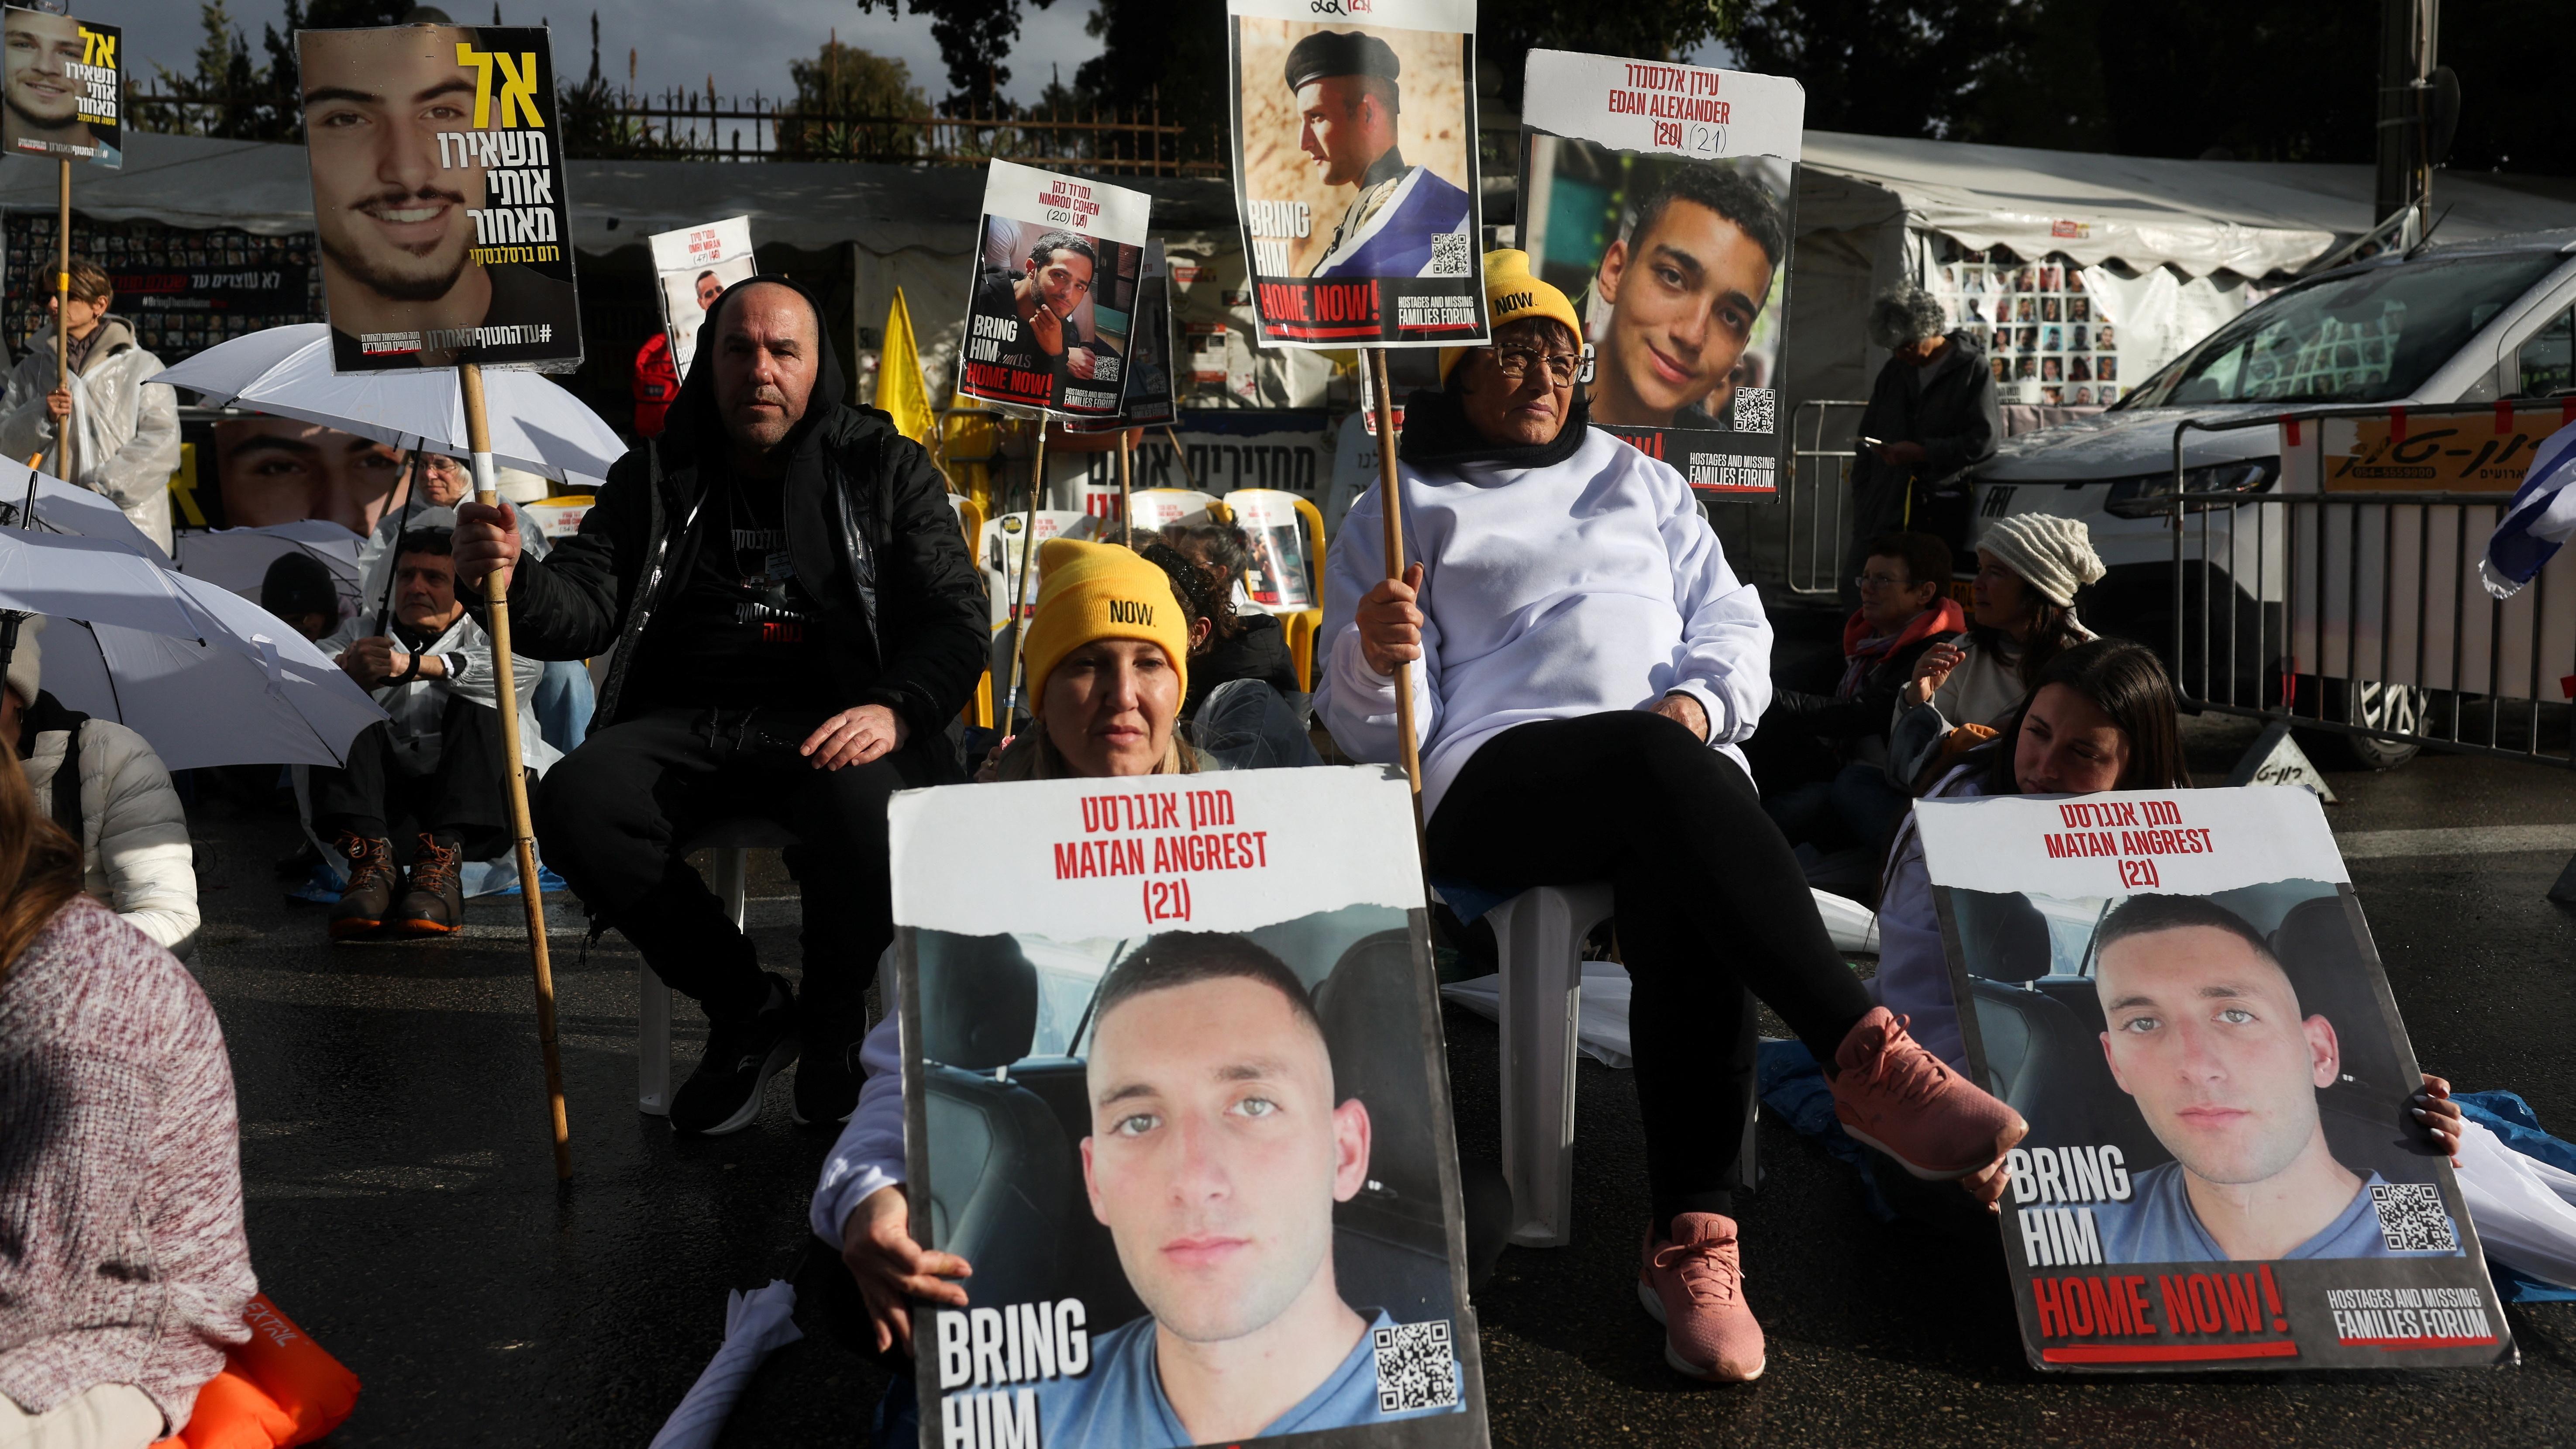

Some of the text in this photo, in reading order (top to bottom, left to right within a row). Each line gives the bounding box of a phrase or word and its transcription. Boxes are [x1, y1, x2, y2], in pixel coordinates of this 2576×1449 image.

[78, 26, 116, 69] אל
[65, 62, 116, 85] תשאירו
[456, 43, 544, 128] אל
[1625, 64, 1719, 96] עידן אלכסנדר
[86, 82, 116, 101] אותי
[75, 96, 116, 117] מאחור
[1609, 90, 1730, 124] EDAN ALEXANDER
[1654, 120, 1682, 149] (20)
[1689, 123, 1726, 153] (21)
[437, 131, 549, 168] תשאירו
[487, 169, 554, 205] אותי
[1052, 180, 1091, 199] נמרוד כהן
[1039, 192, 1099, 216] NIMROD COHEN
[1047, 209, 1070, 224] (20)
[467, 207, 557, 244] מאחור
[1247, 200, 1310, 238] BRING
[469, 245, 559, 266] רום ברסלבסקי
[689, 238, 721, 253] OMRI MIRAN
[1253, 240, 1288, 277] HIM
[191, 273, 209, 289] עד
[211, 271, 259, 289] עוצרים
[263, 270, 280, 290] לא
[1259, 279, 1380, 321] HOME NOW!
[1398, 296, 1473, 308] HOSTAGES AND MISSING
[1495, 292, 1537, 316] NOW.
[973, 314, 1018, 342] BRING
[1398, 308, 1475, 326] FAMILIES FORUM
[361, 331, 420, 342] מטה המשפחות להחזרת
[362, 340, 421, 353] החטופים והנעדרים
[969, 338, 999, 362] HIM
[677, 345, 696, 364] BRI
[966, 362, 1054, 397] HOME NOW!
[1066, 387, 1088, 397] HOSTAGES
[1064, 394, 1116, 409] FAMILIES FORUM
[1188, 445, 1316, 490] מחזירים
[1690, 452, 1775, 469] HOSTAGES AND MISSING
[1689, 466, 1774, 488] FAMILIES FORUM
[1981, 486, 2018, 517] FIAT
[1110, 600, 1156, 627] NOW.
[1081, 790, 1234, 833] מתן אנגרסט
[2059, 800, 2183, 828] מתן אנגרסט
[1054, 831, 1267, 880] MATAN ANGREST
[2044, 828, 2213, 858] MATAN ANGREST
[2118, 859, 2159, 888] (21)
[1143, 878, 1190, 924] (21)
[2007, 1145, 2131, 1204] BRING
[2018, 1208, 2102, 1266] HIM
[2032, 1263, 2287, 1338] HOME NOW!
[2327, 1288, 2481, 1309] HOSTAGES AND MISSING
[2333, 1309, 2492, 1339] FAMILIES FORUM
[937, 1297, 1088, 1389] BRING
[941, 1387, 1038, 1449] HIM
